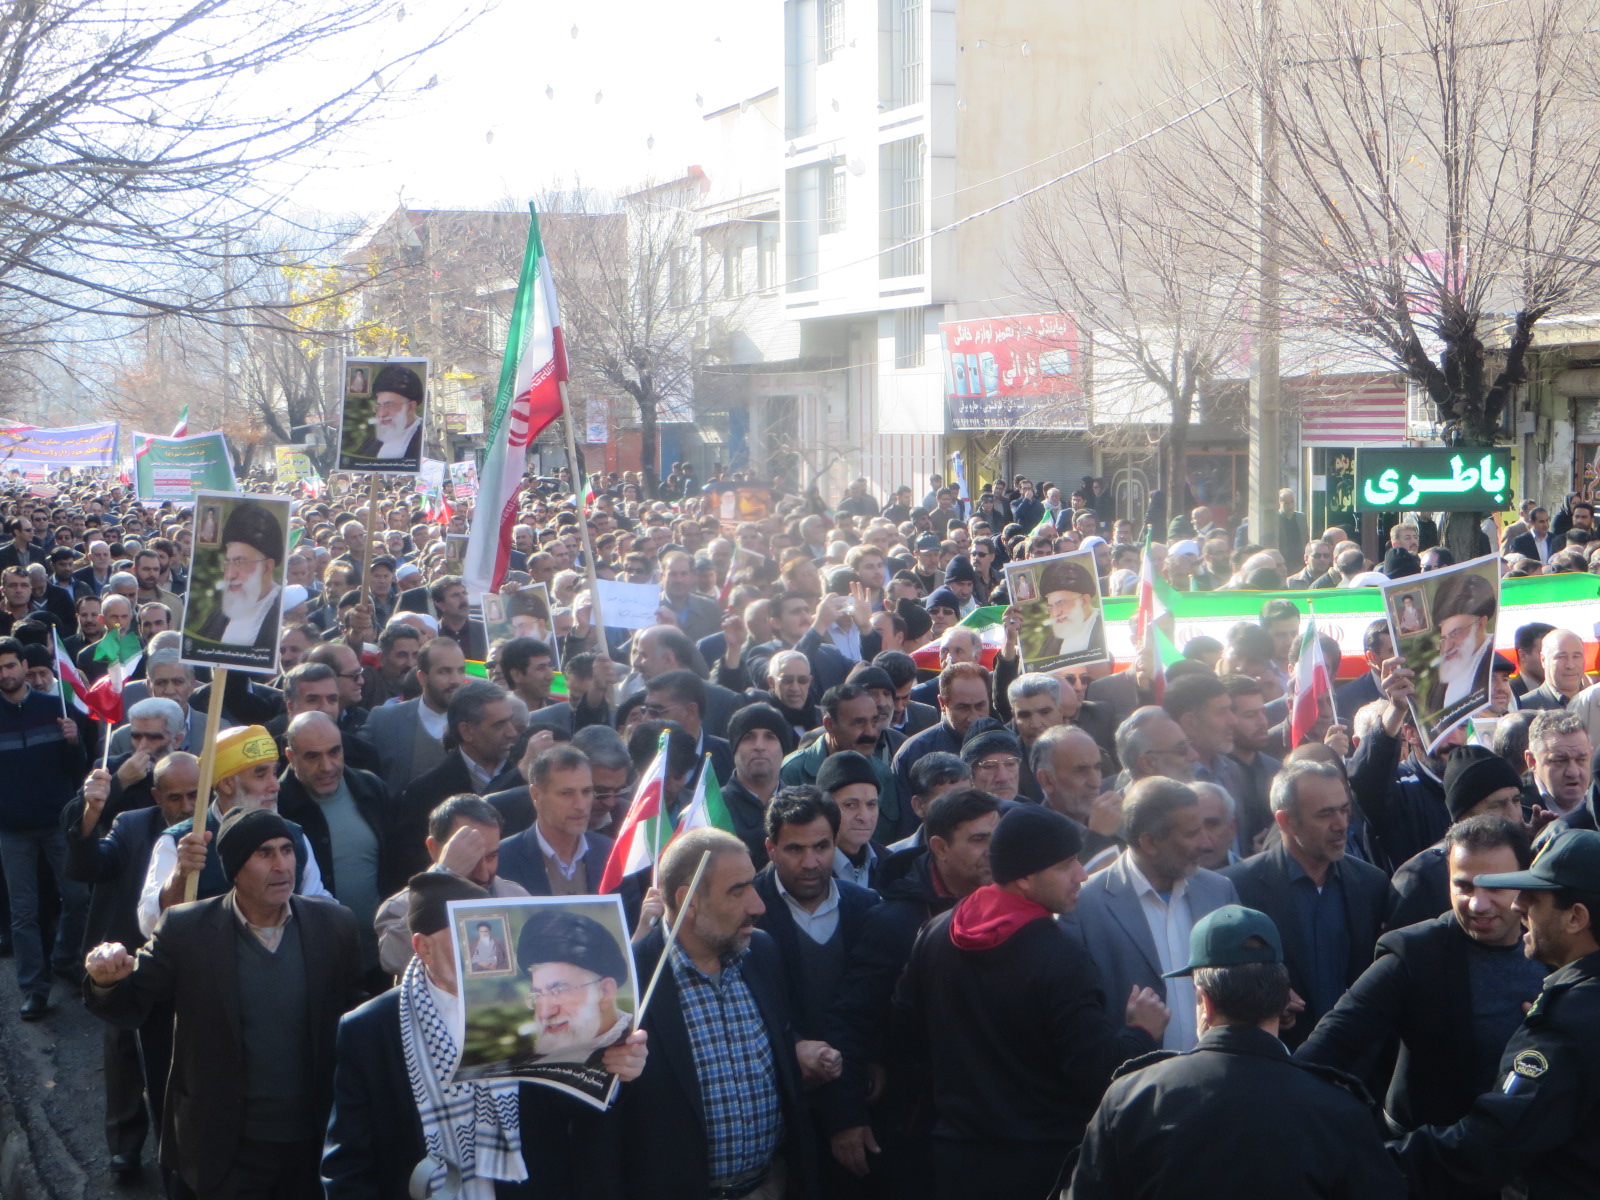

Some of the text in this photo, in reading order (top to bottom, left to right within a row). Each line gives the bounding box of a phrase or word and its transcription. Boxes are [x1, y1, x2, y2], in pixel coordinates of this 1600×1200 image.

[953, 324, 973, 346] خانگی
[975, 323, 993, 345] لوازم
[1364, 454, 1506, 505] باطری
